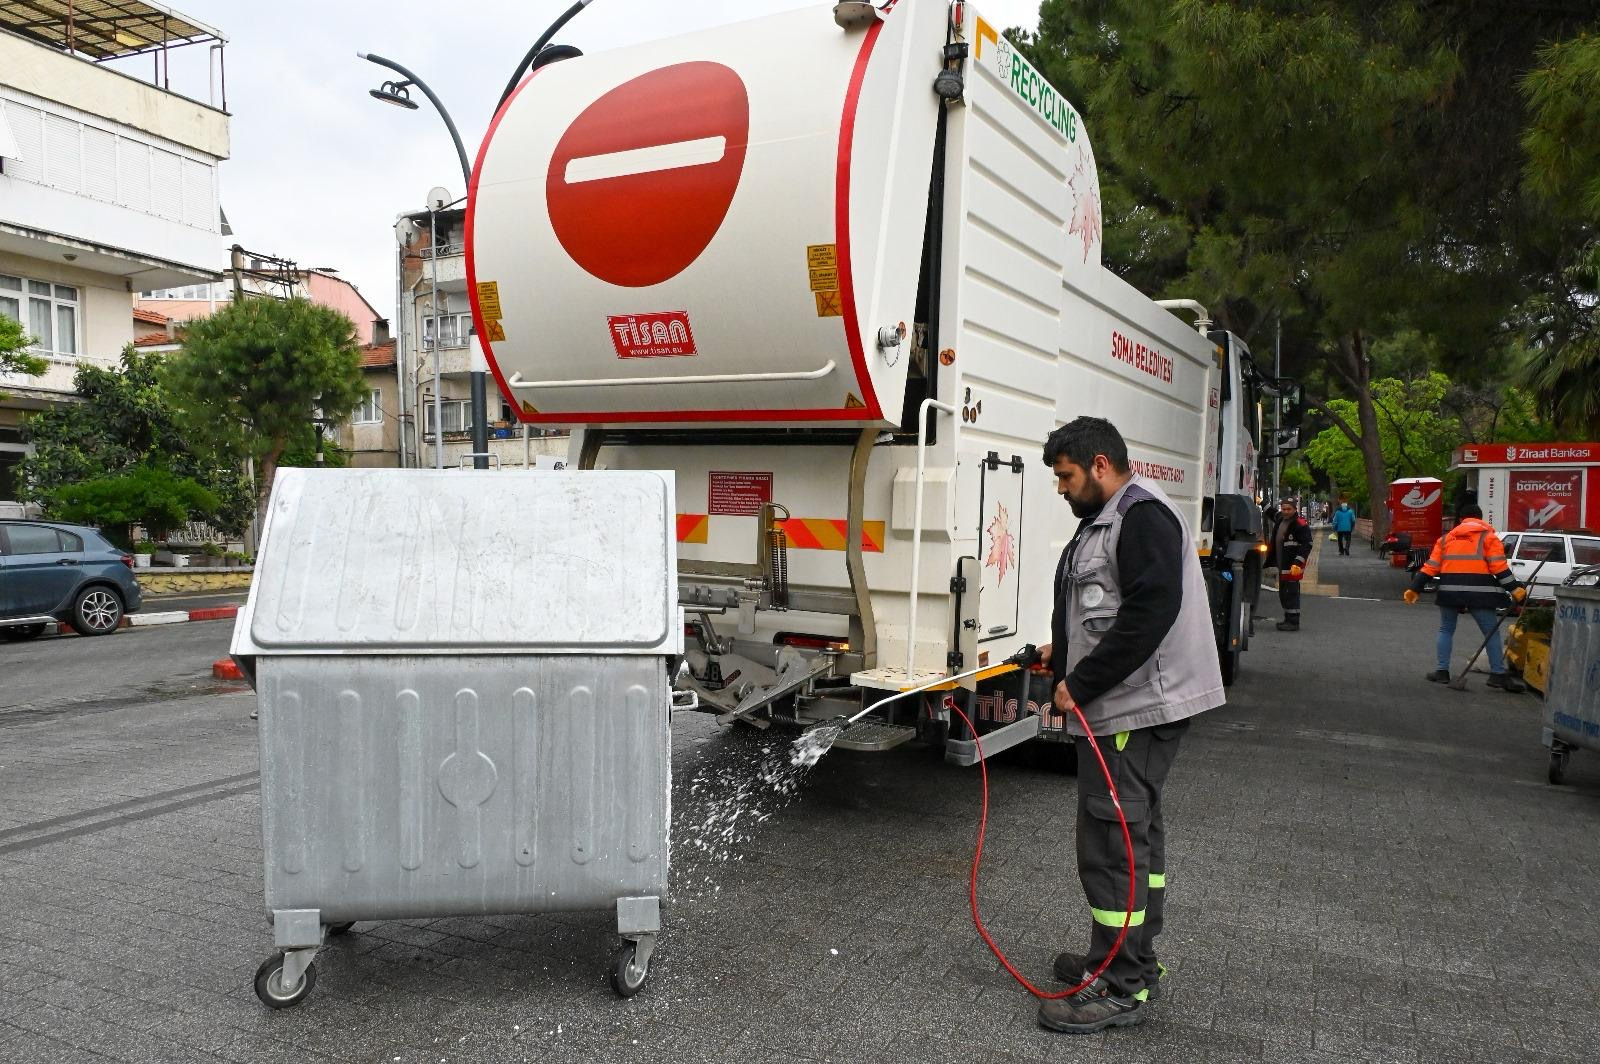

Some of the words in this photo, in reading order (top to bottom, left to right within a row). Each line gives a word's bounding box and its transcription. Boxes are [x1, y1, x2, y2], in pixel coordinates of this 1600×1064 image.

[1011, 53, 1076, 143] RECYCLING
[629, 346, 683, 355] www.tisan.eu
[1111, 330, 1134, 366] SOMA
[1135, 343, 1174, 384] BELEDİYESİ
[1518, 448, 1549, 459] Ziraat
[1550, 446, 1590, 458] Bankası
[1559, 604, 1587, 624] SOMA
